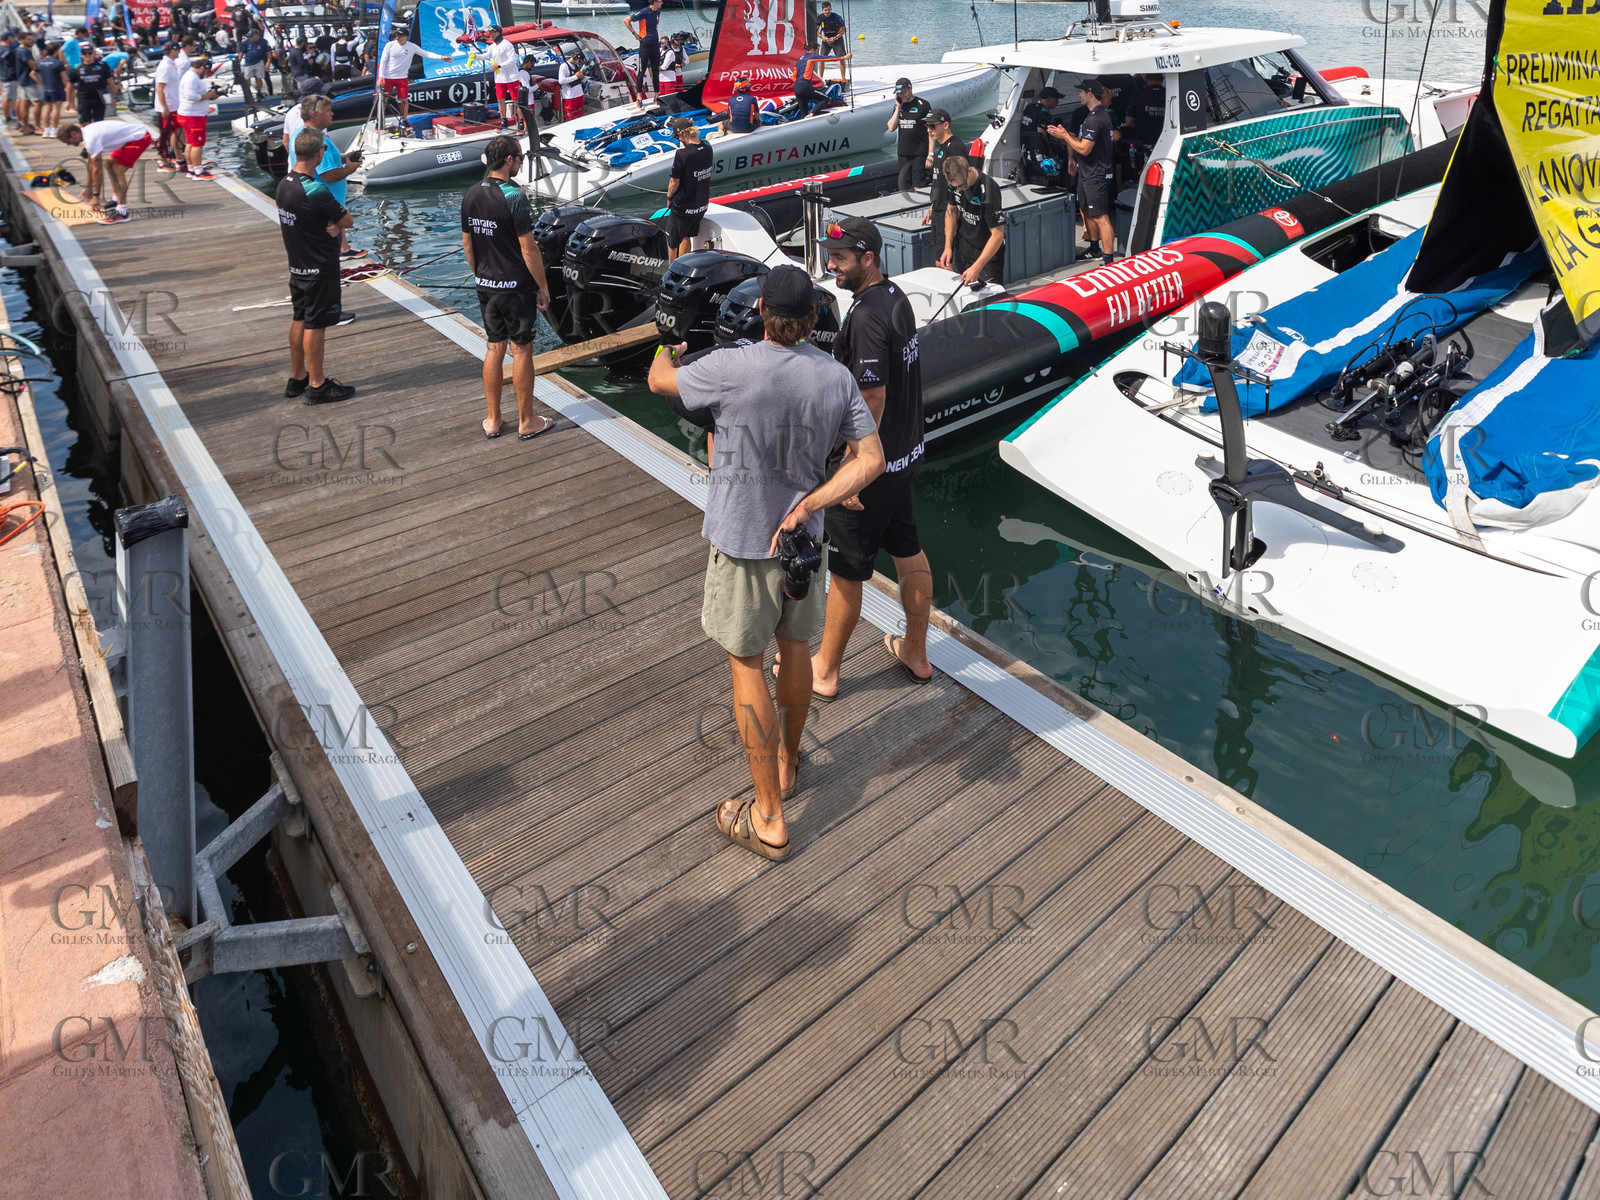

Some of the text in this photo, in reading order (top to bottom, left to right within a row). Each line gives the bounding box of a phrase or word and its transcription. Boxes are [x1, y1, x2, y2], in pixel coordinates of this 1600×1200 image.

[1140, 4, 1161, 12] SIMR
[407, 90, 442, 102] RIENT
[1188, 94, 1198, 106] 2
[735, 136, 851, 171] BRITANNIA
[608, 250, 664, 268] MERCURY
[1056, 246, 1184, 298] Emirates
[1106, 270, 1185, 328] FLY BETTER
[809, 330, 838, 343] CURY
[886, 453, 910, 473] NEW
